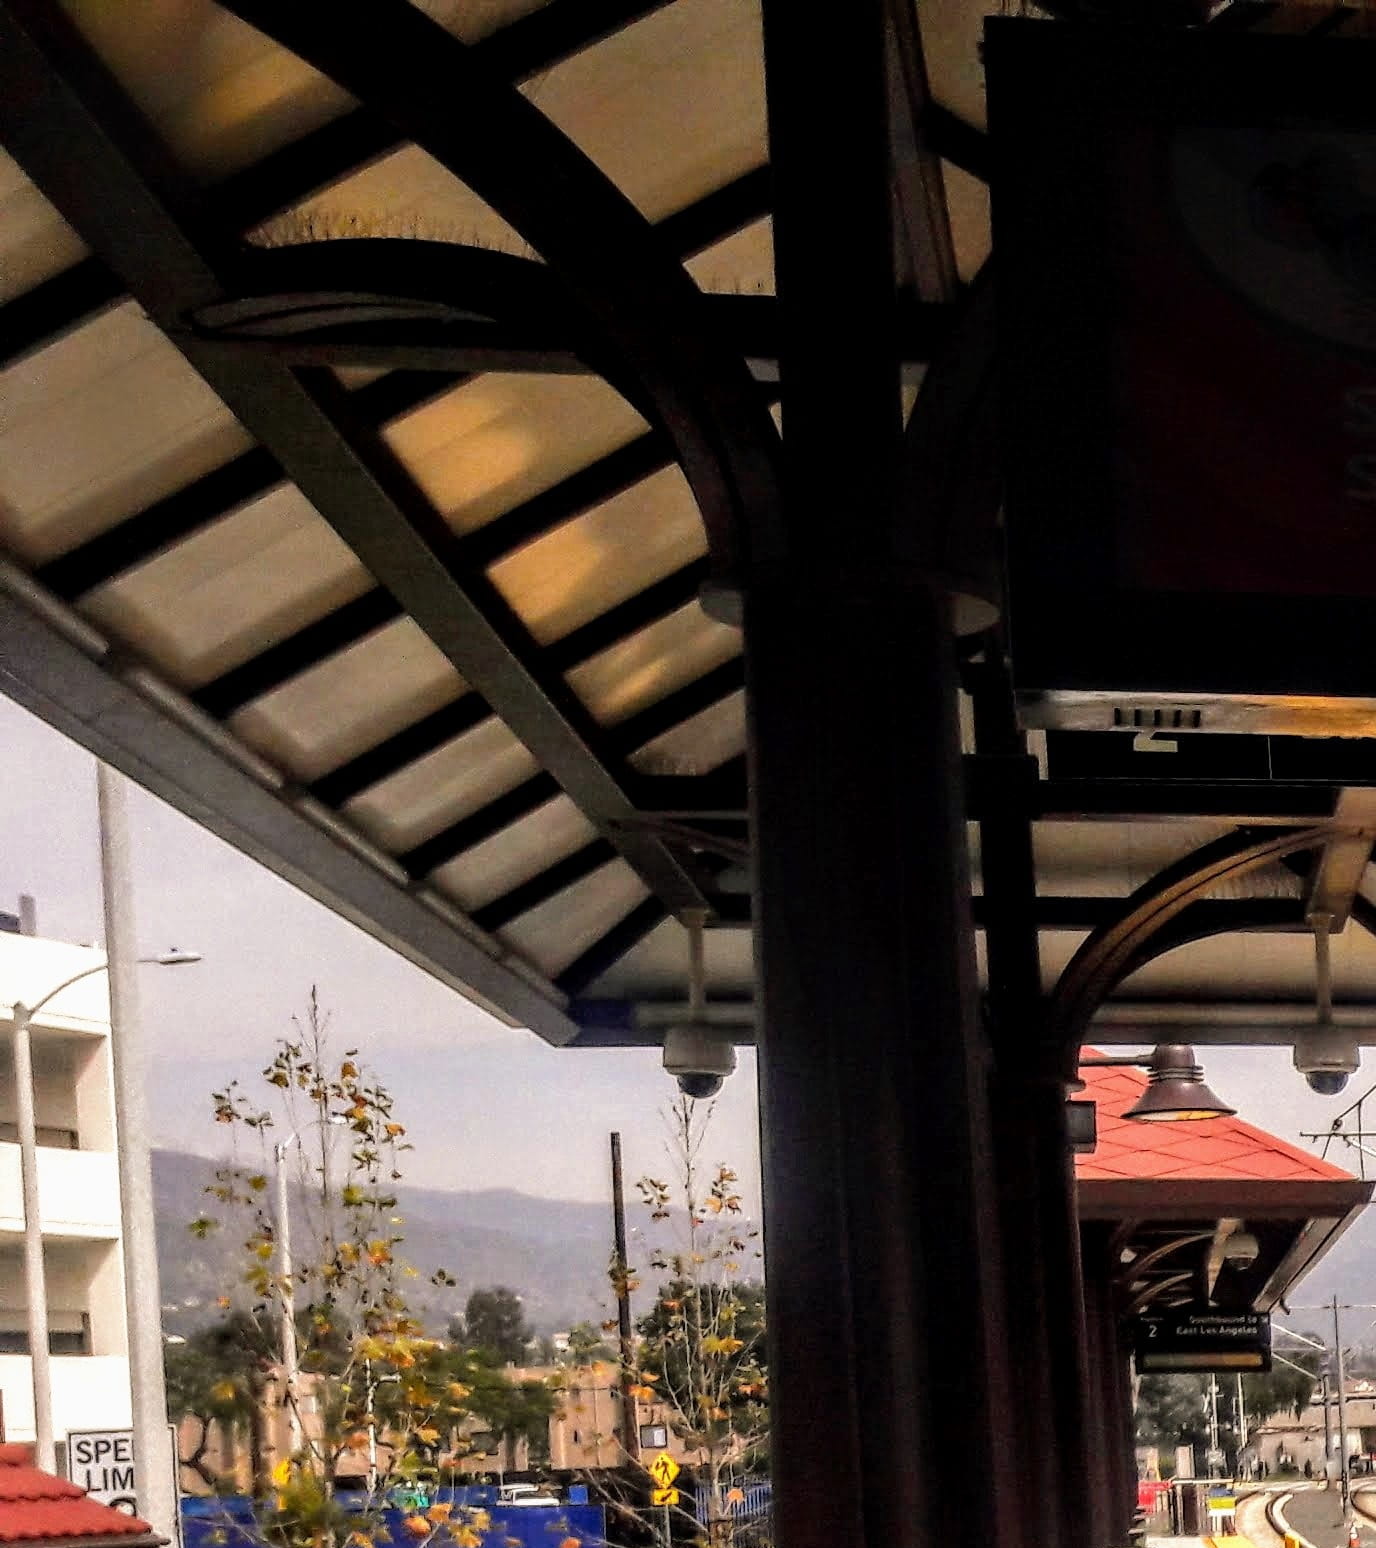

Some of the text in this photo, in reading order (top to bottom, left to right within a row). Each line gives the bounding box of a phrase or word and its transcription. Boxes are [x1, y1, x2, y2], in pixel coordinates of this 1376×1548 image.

[1148, 1325, 1158, 1338] 2
[1219, 1325, 1258, 1337] Angeles
[76, 1438, 134, 1464] SPE
[86, 1467, 134, 1493] LIM
